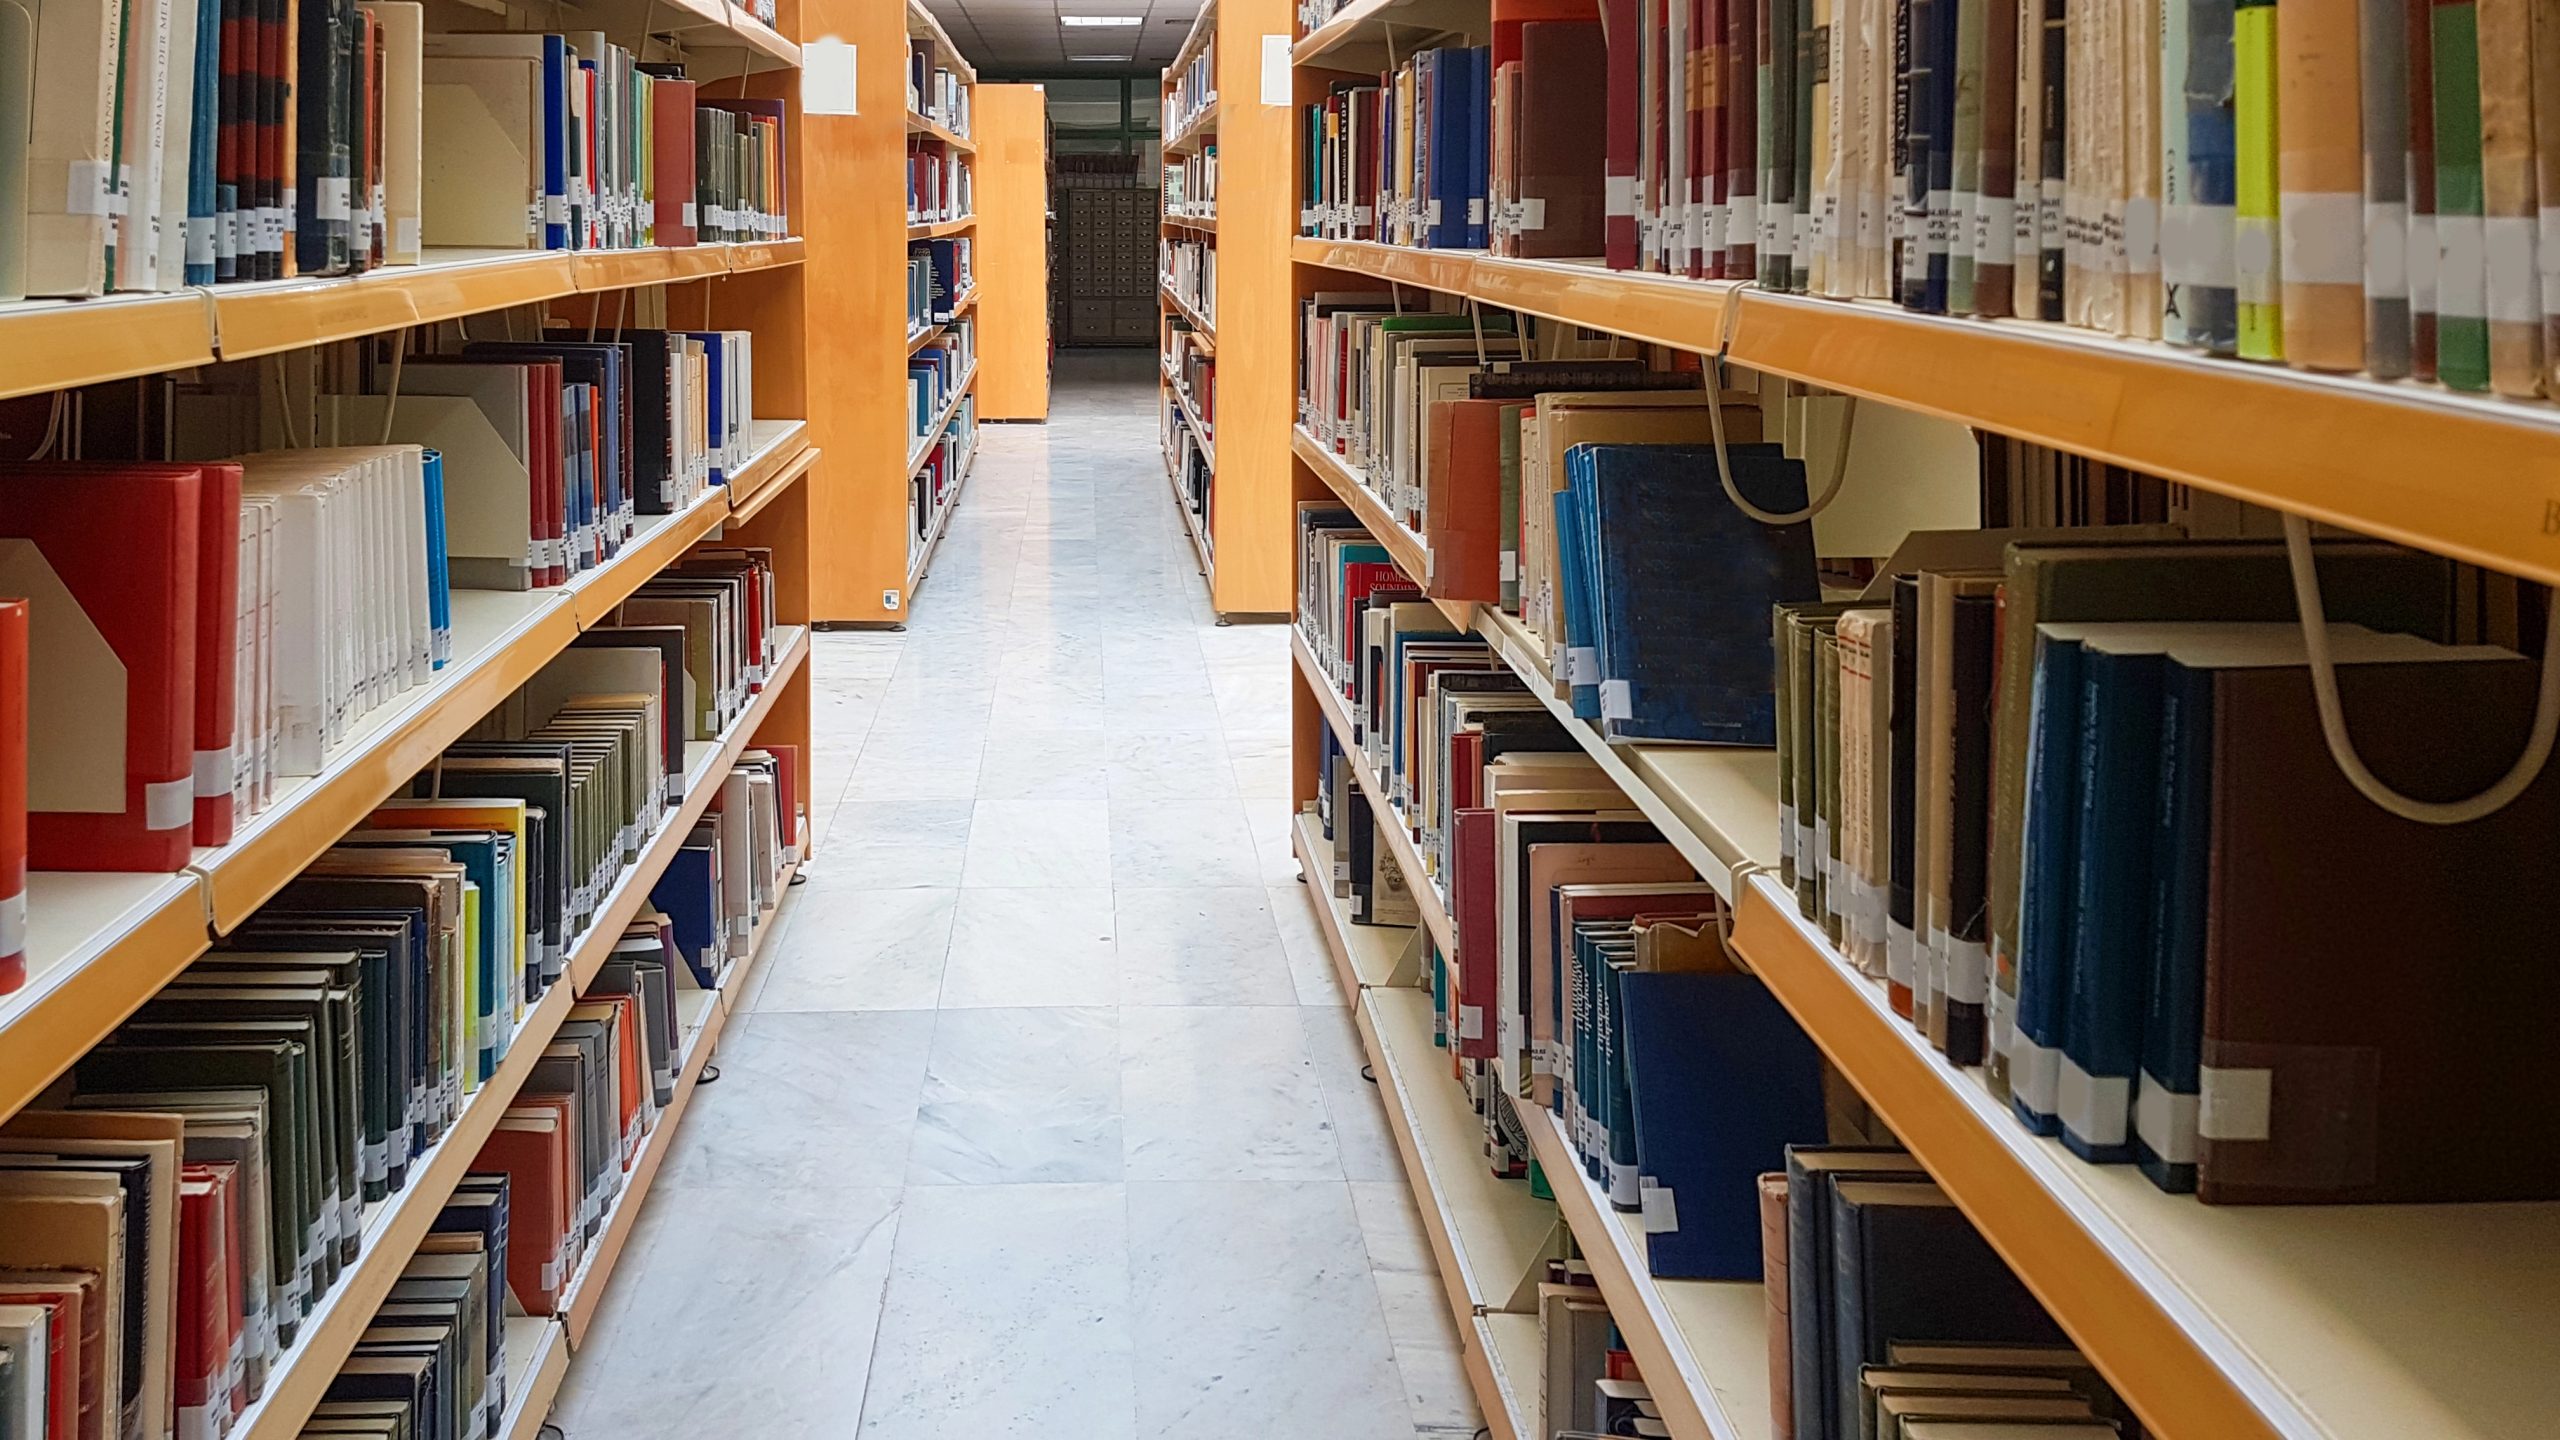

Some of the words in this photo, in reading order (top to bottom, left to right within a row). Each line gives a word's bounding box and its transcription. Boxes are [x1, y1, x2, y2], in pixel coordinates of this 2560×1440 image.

[158, 35, 167, 65] DER
[103, 84, 113, 160] OMANOS
[154, 71, 165, 148] ROMANOS
